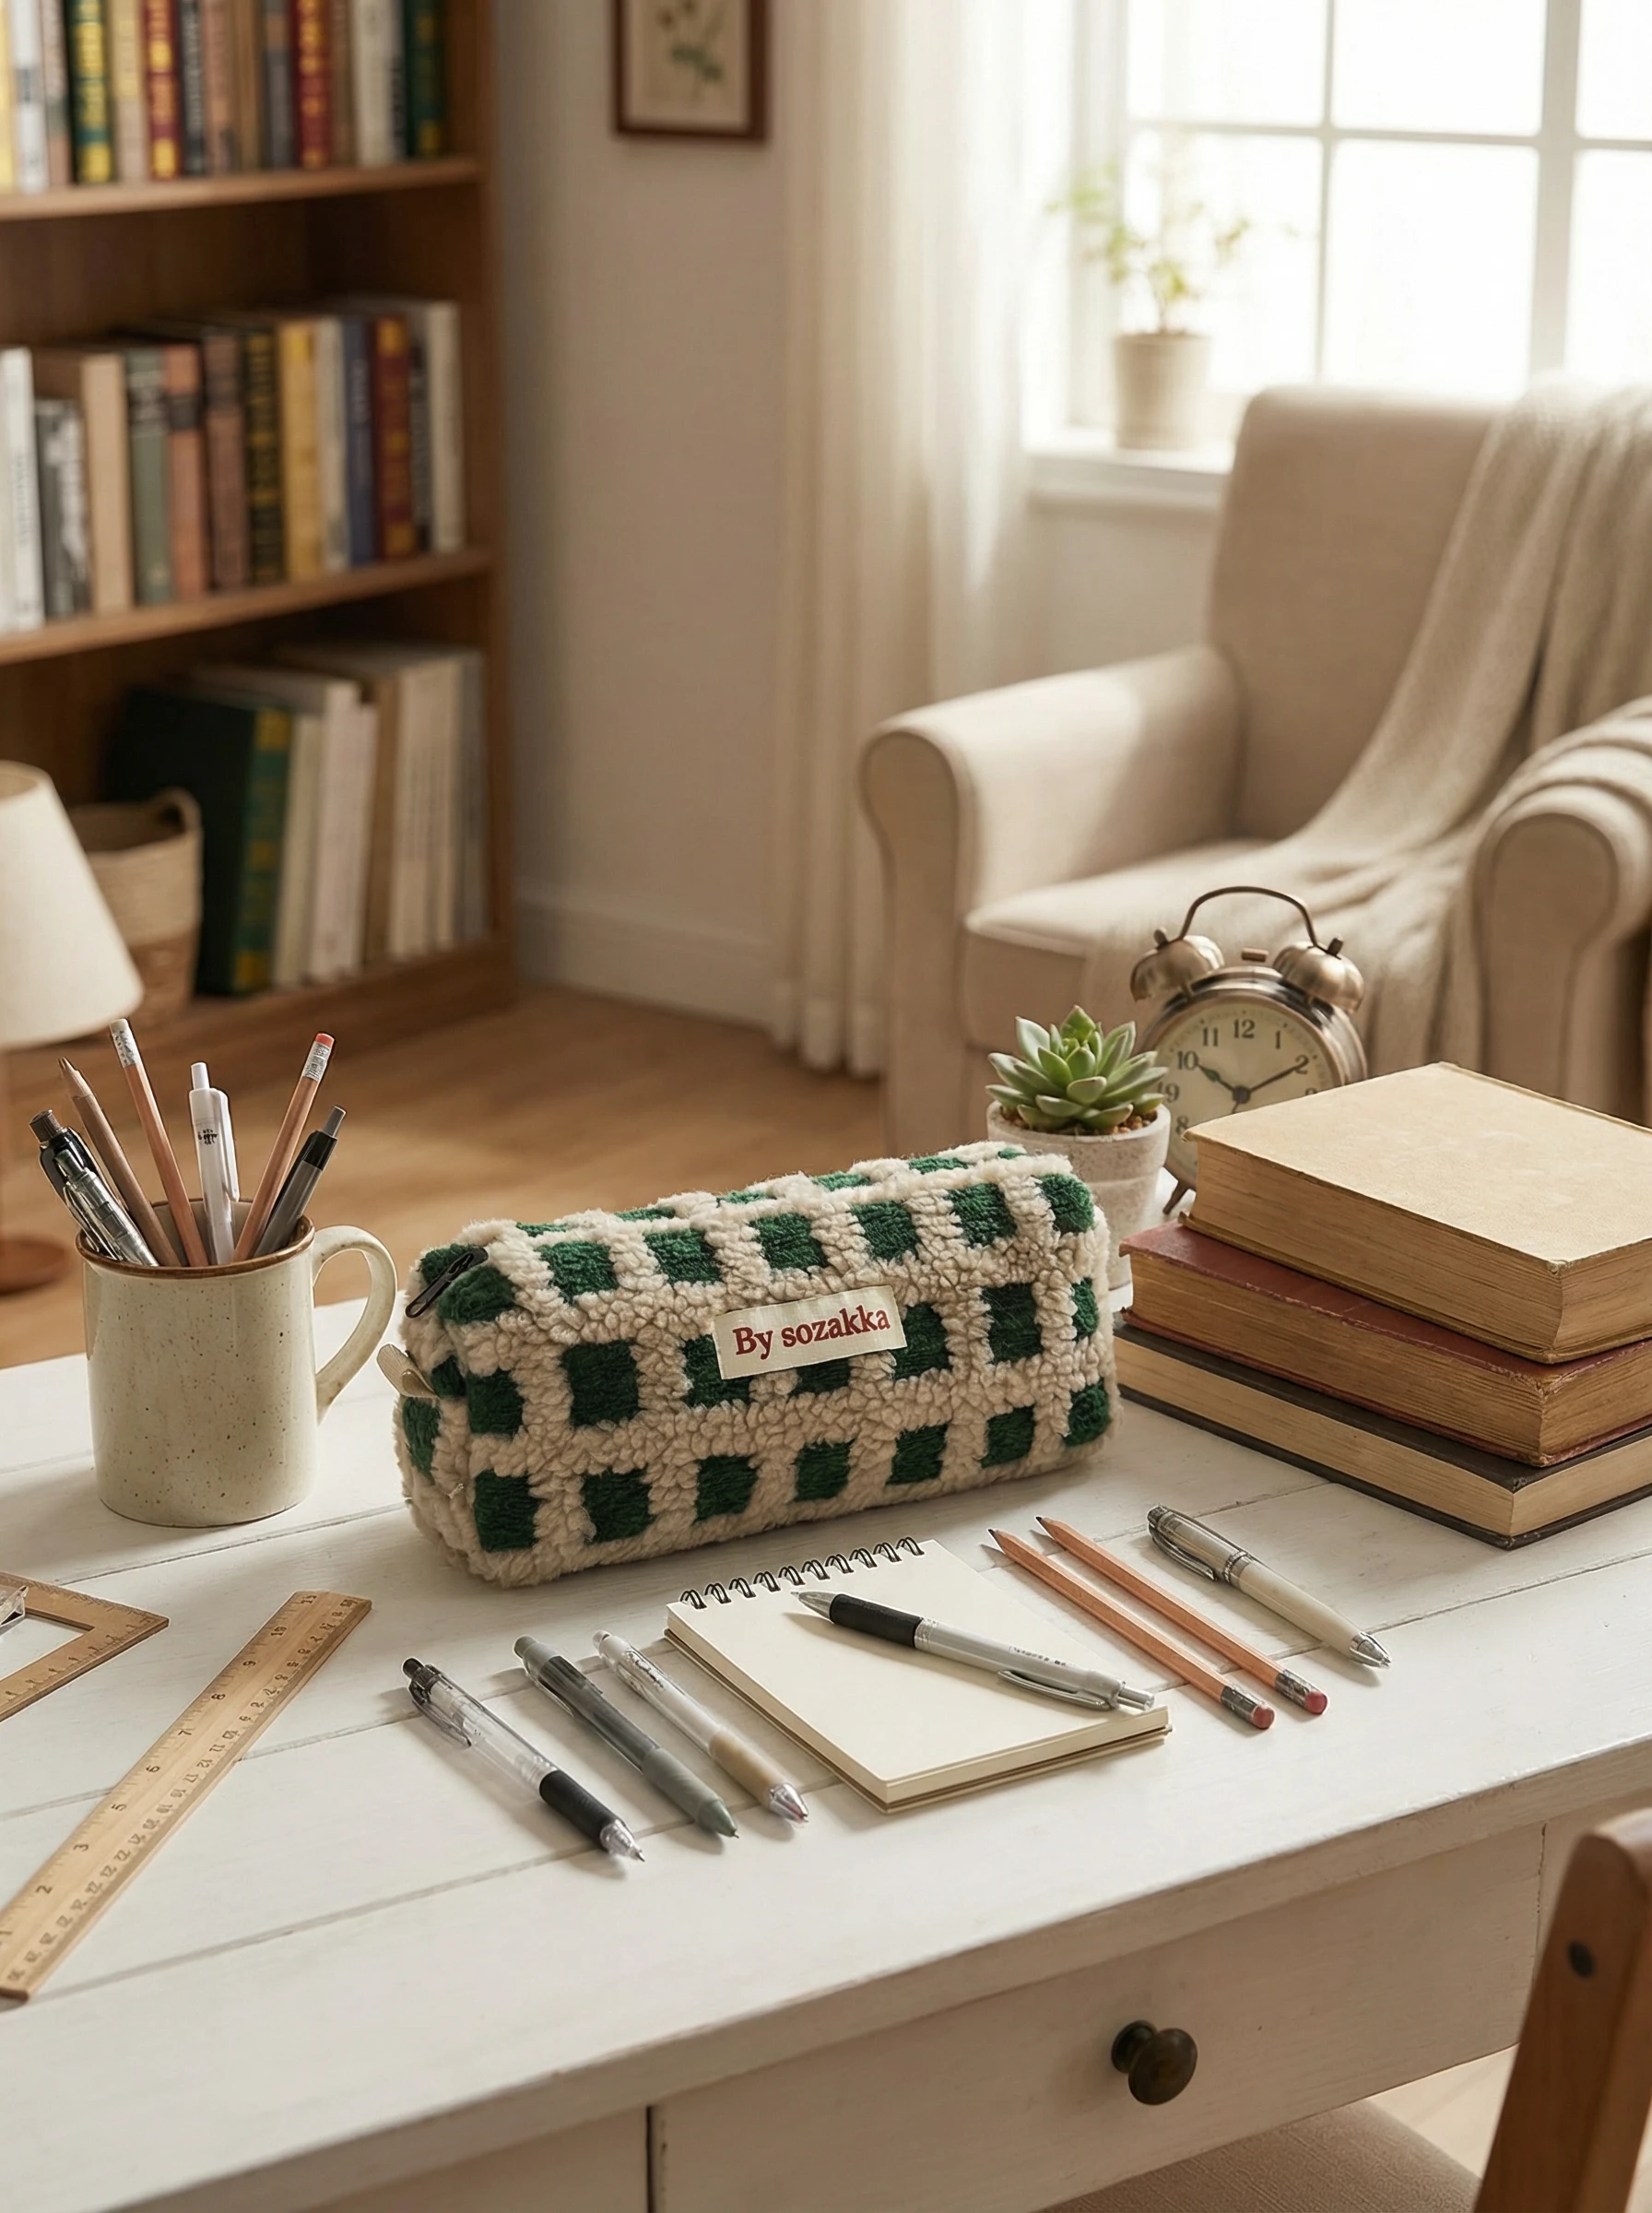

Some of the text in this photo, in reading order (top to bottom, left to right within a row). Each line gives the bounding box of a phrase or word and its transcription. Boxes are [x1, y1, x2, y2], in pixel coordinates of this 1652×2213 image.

[1202, 1027, 1219, 1047] 11
[1233, 1019, 1256, 1038] 12
[1275, 1030, 1281, 1049] 1
[1177, 1050, 1198, 1071] 10
[1294, 1054, 1310, 1074] 2
[732, 1305, 891, 1360] By sozakka
[34, 1885, 53, 1895] 2
[73, 1843, 89, 1852] 3
[111, 1804, 127, 1812] 5
[146, 1765, 160, 1773] 6
